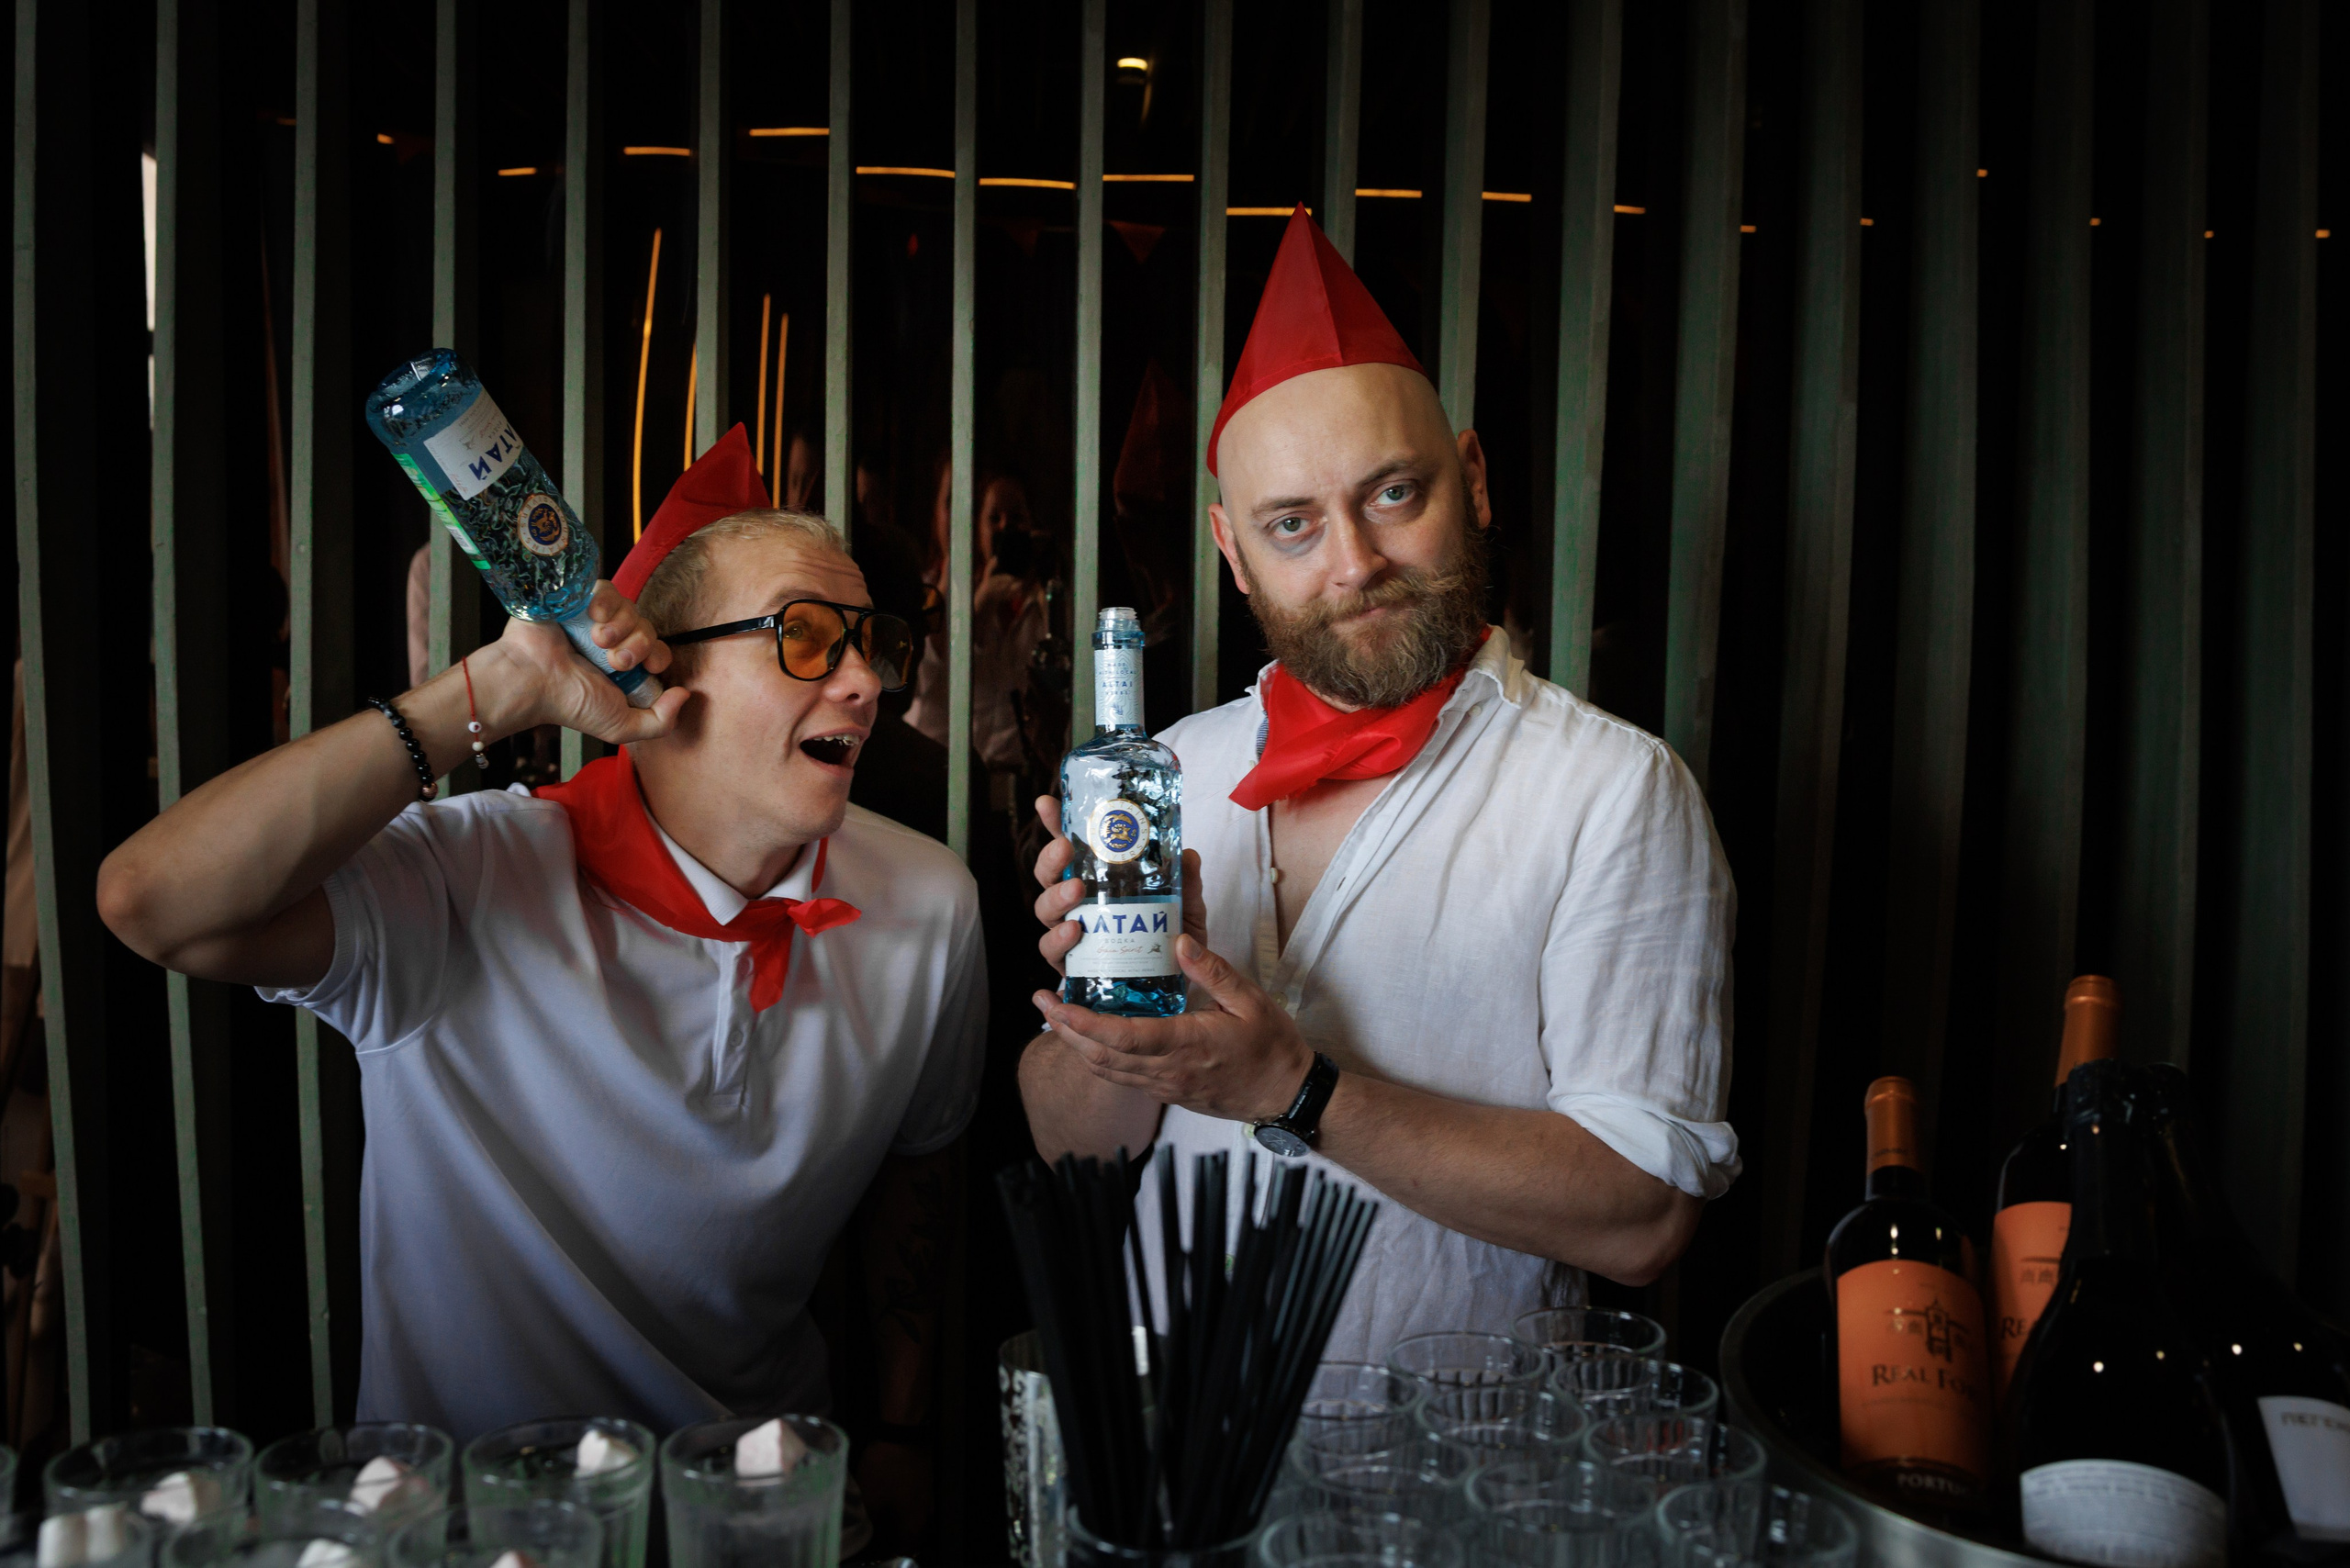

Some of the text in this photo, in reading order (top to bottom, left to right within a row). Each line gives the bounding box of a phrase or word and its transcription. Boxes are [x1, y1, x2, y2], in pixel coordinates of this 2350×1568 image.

[468, 423, 517, 481] ЛТАЙ
[1078, 911, 1168, 934] АЛТАЙ
[2000, 1316, 2025, 1341] RE
[1873, 1363, 1931, 1387] REAL
[1897, 1473, 1971, 1497] PORTU
